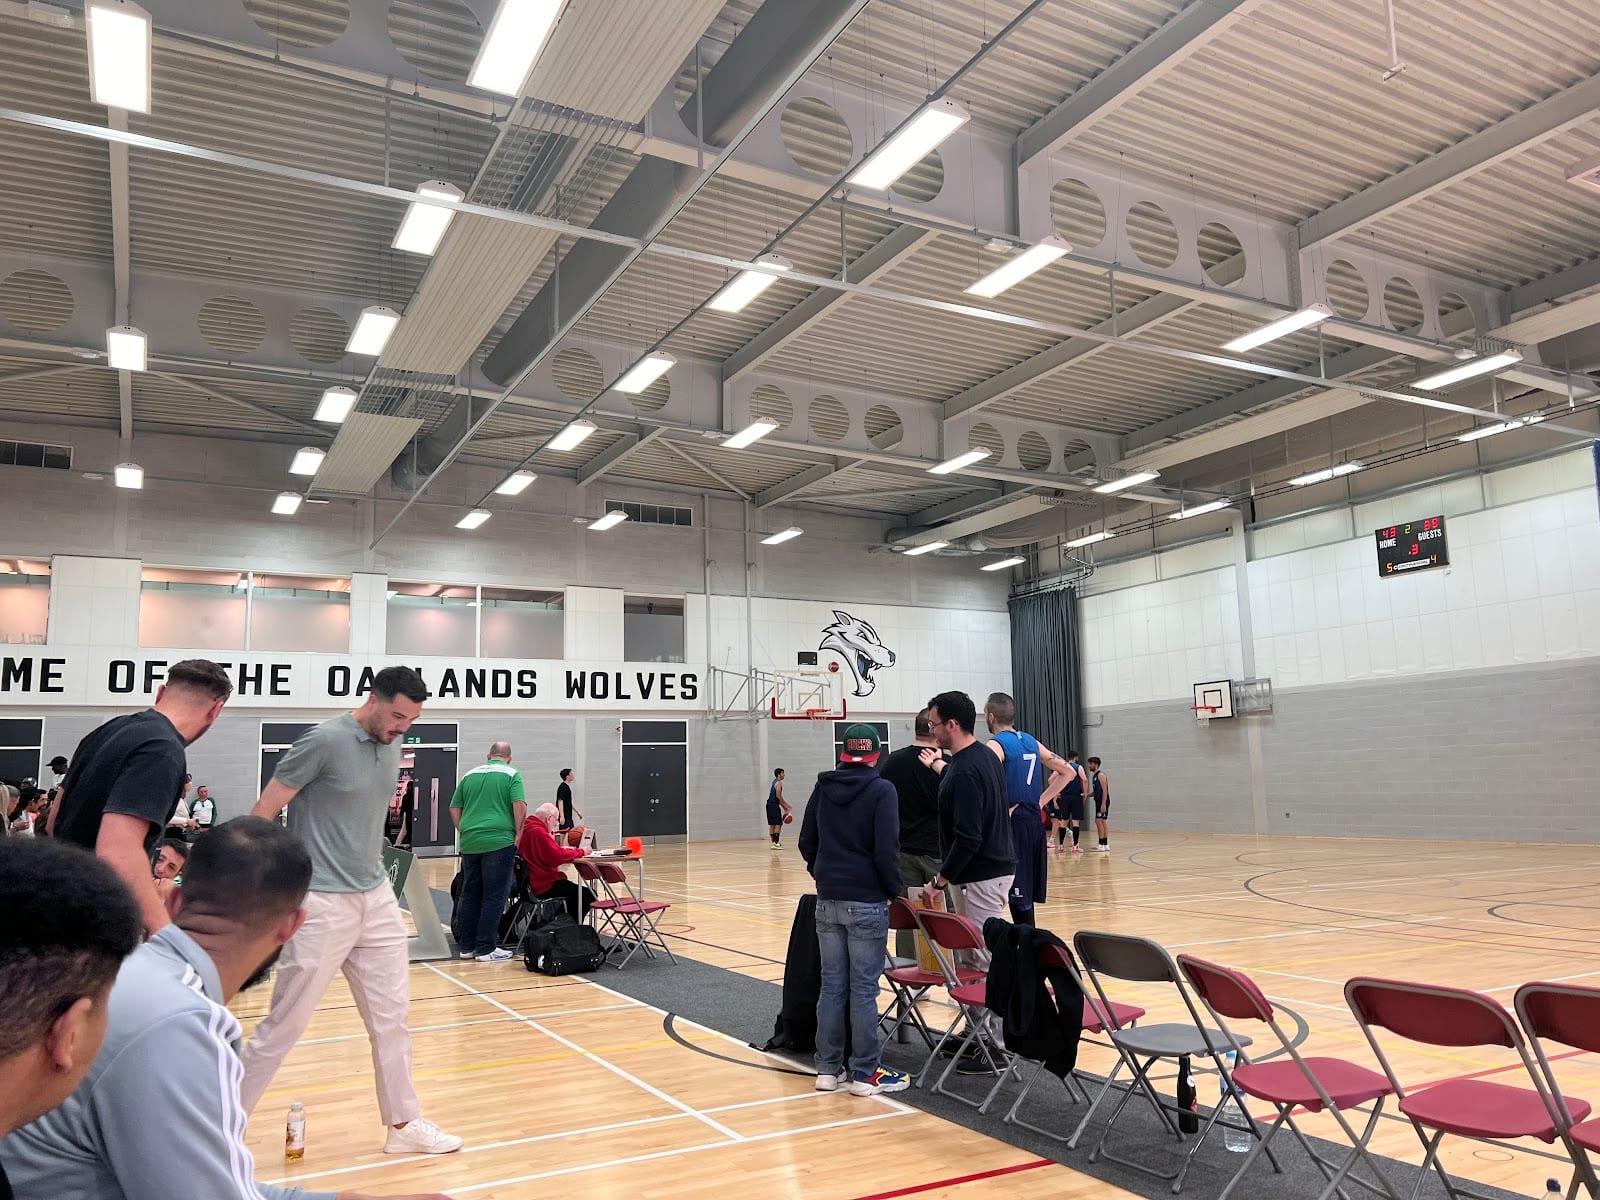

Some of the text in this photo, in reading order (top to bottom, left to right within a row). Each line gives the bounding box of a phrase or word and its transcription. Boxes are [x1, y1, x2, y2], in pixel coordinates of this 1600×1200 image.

[1379, 529, 1442, 548] HOME GUESTS
[1382, 527, 1397, 538] 43
[1404, 524, 1411, 534] 2
[1430, 554, 1437, 564] 4
[1, 657, 698, 700] ME OF HE OAANDS WOLVES
[1022, 753, 1037, 785] 7
